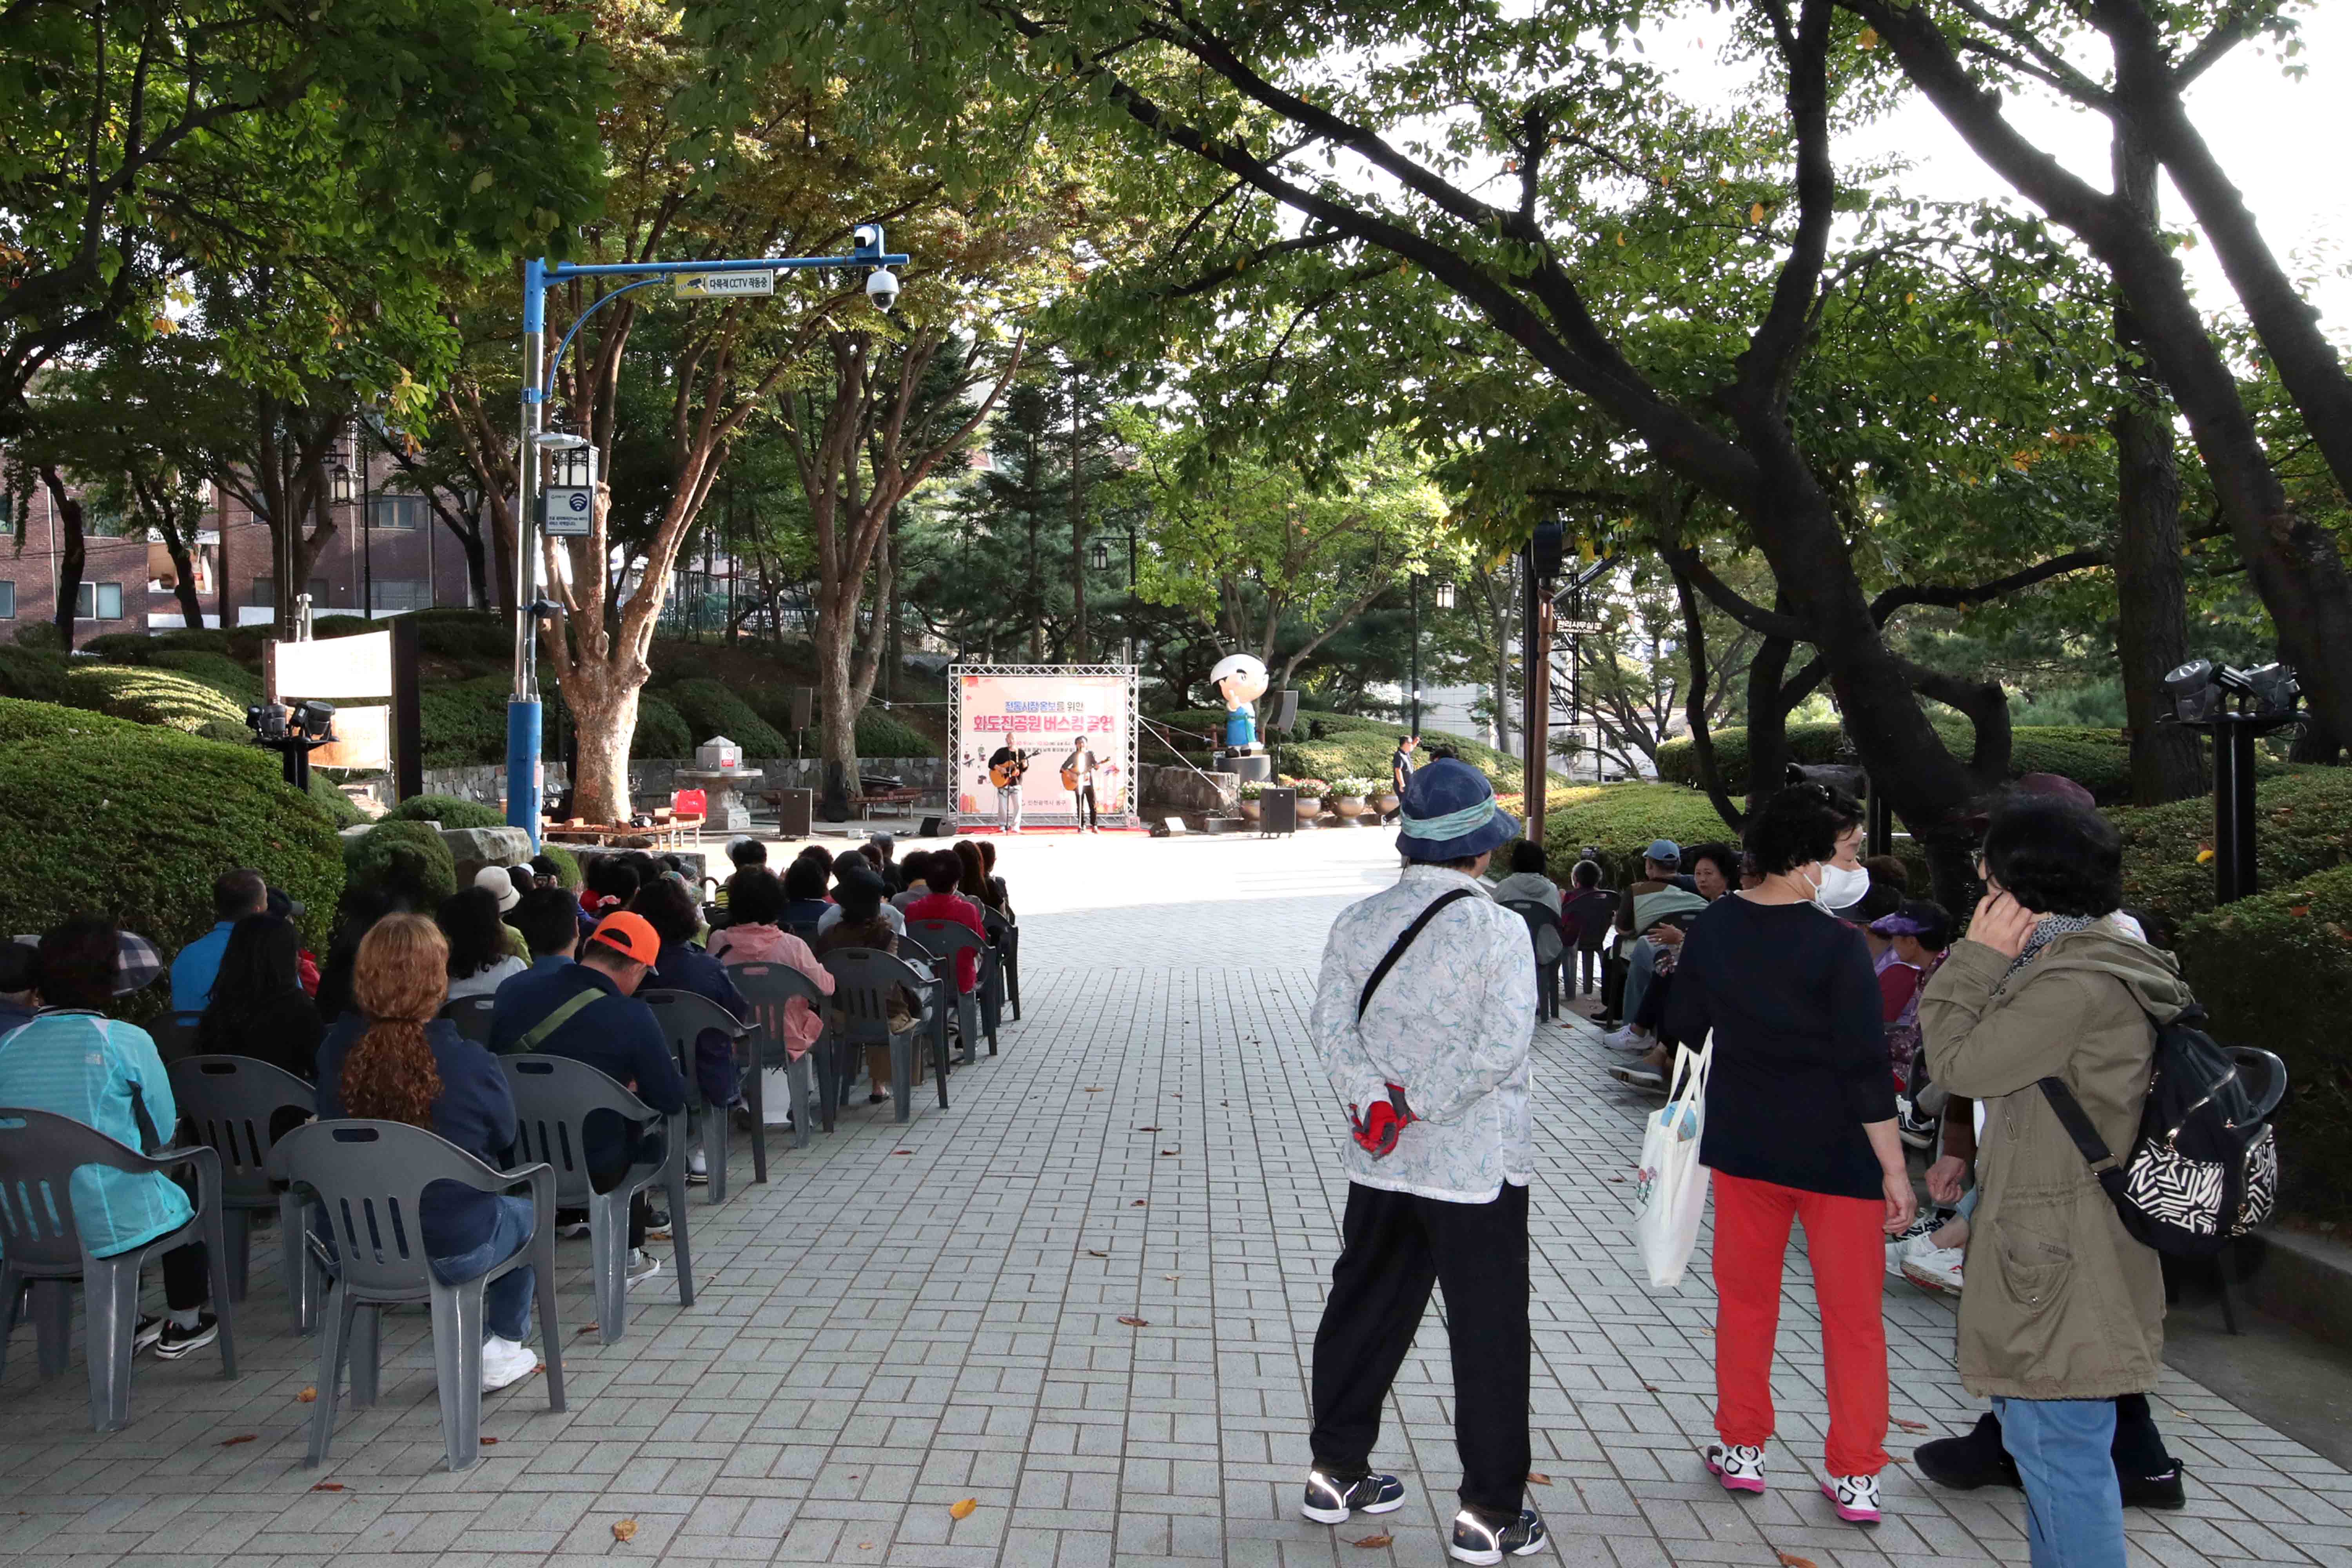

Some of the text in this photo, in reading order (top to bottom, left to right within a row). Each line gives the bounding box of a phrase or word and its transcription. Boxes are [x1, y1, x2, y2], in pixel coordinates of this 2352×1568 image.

[710, 277, 767, 289] 다목적 CCTV 작동중
[1557, 620, 1593, 629] 관리사무실
[1067, 701, 1084, 712] 위한
[973, 715, 1115, 732] 화도진공원 버스킹 공연
